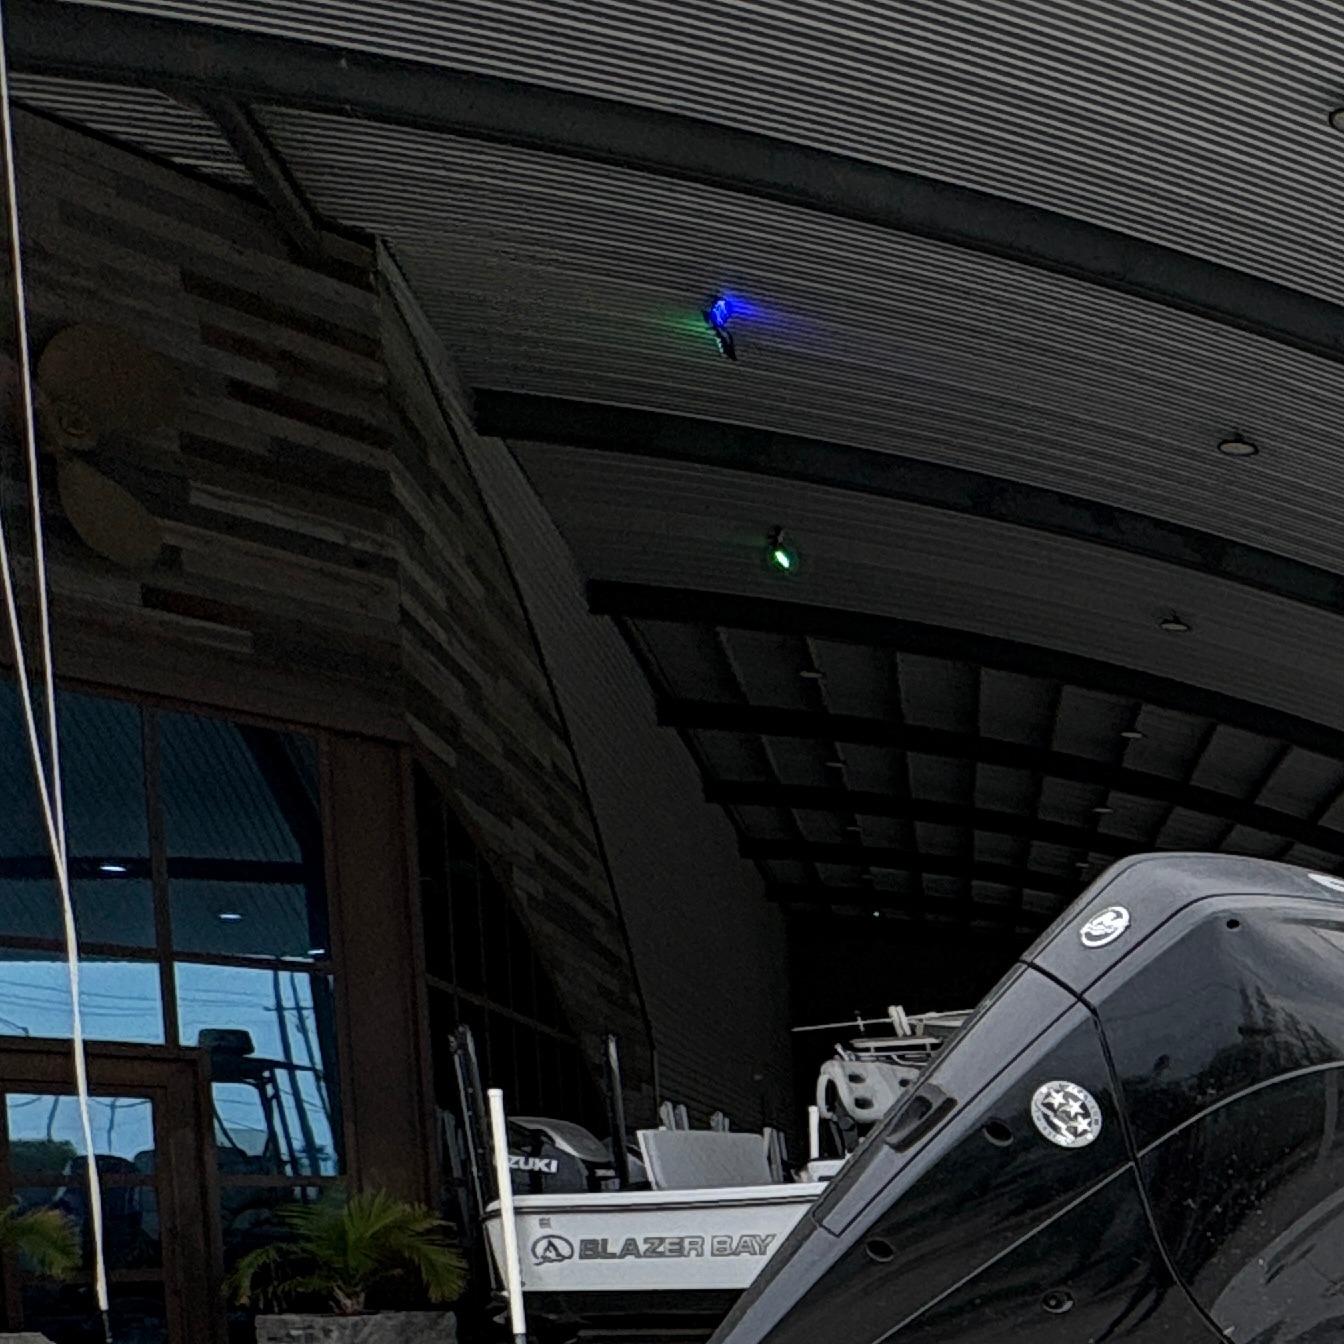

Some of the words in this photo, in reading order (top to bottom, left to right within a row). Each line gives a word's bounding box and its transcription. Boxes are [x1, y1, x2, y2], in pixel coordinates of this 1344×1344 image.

[508, 1155, 557, 1173] ZUKI
[578, 1236, 706, 1260] BLAZER
[711, 1234, 777, 1257] BAY
